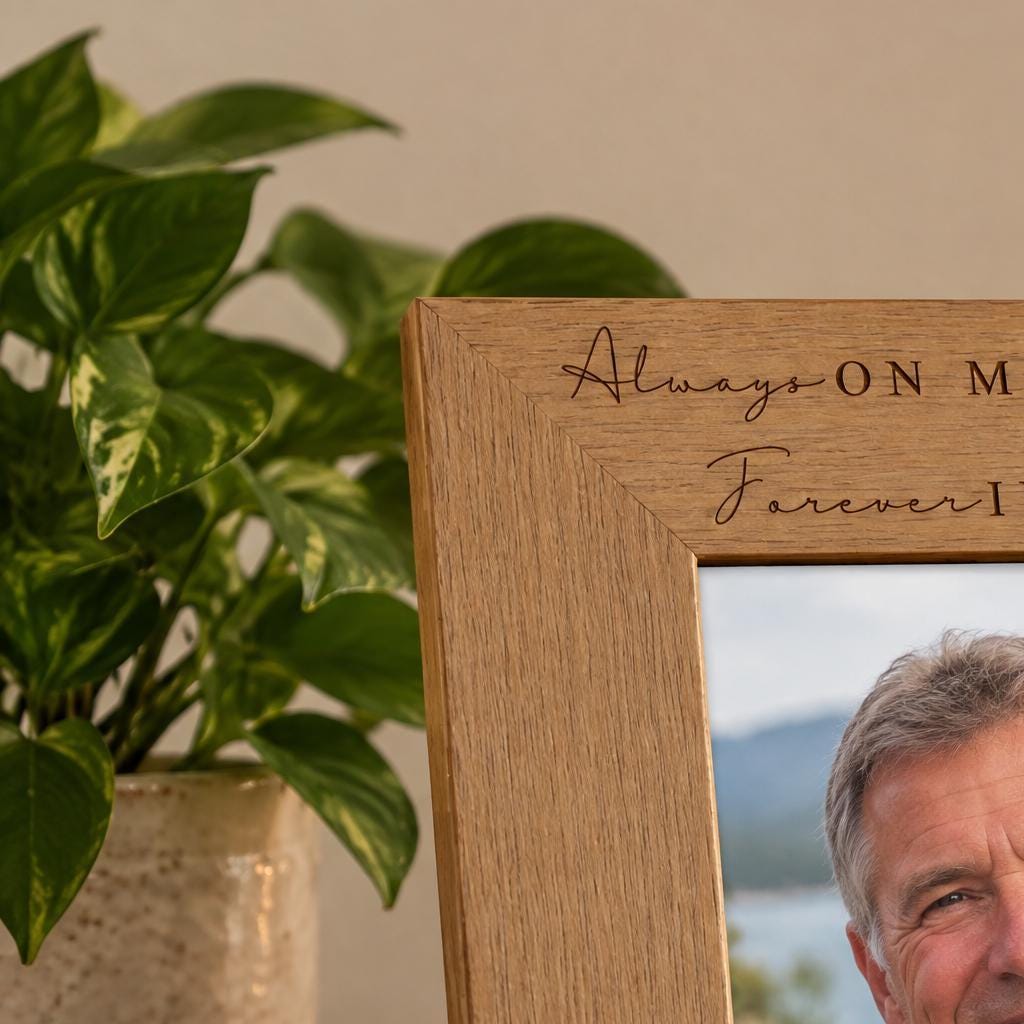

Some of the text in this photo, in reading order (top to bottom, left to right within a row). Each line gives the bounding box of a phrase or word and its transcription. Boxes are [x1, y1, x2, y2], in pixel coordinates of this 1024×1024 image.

[562, 325, 826, 422] Always
[835, 360, 922, 396] ON
[706, 446, 982, 525] Forever
